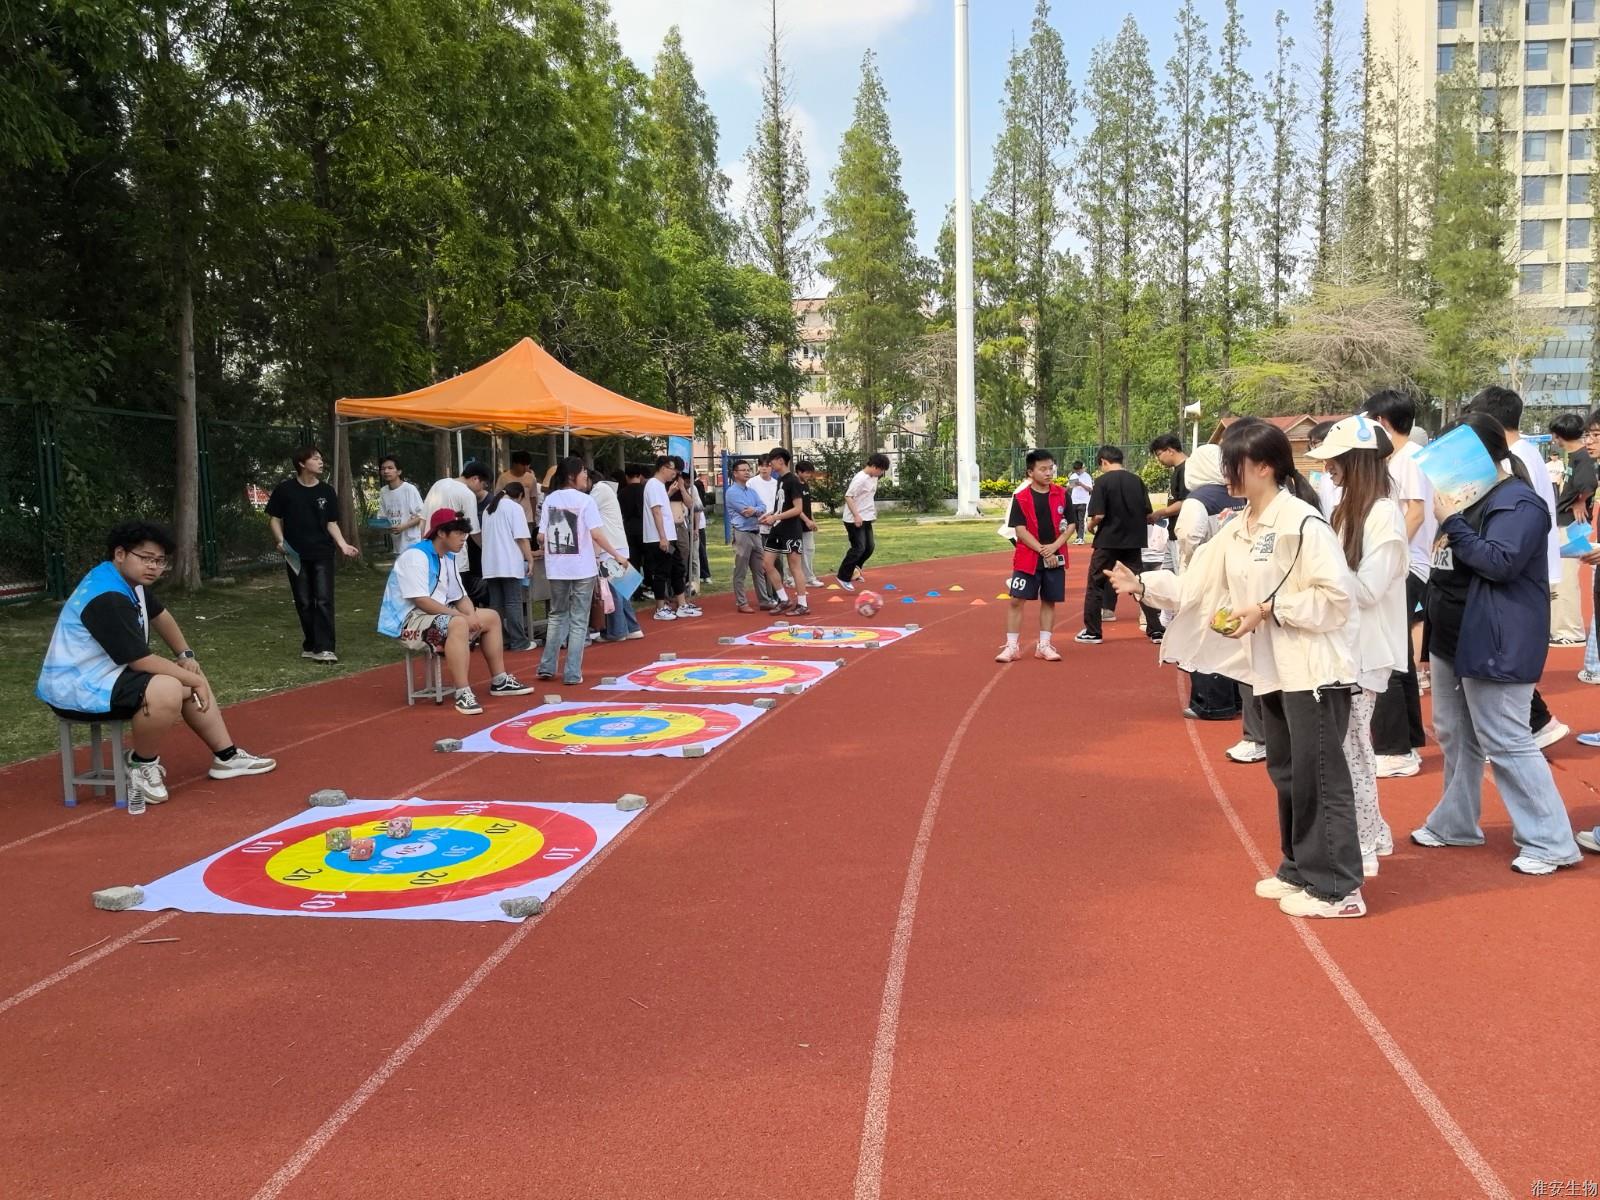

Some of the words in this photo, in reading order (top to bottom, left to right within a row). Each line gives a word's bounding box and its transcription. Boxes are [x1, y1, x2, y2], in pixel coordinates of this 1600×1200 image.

[1011, 577, 1027, 591] 69
[485, 822, 517, 834] 20
[241, 840, 284, 853] 10
[441, 845, 475, 857] 30
[543, 847, 581, 860] 10
[283, 868, 323, 881] 20
[409, 871, 448, 885] 20
[299, 892, 347, 909] 10
